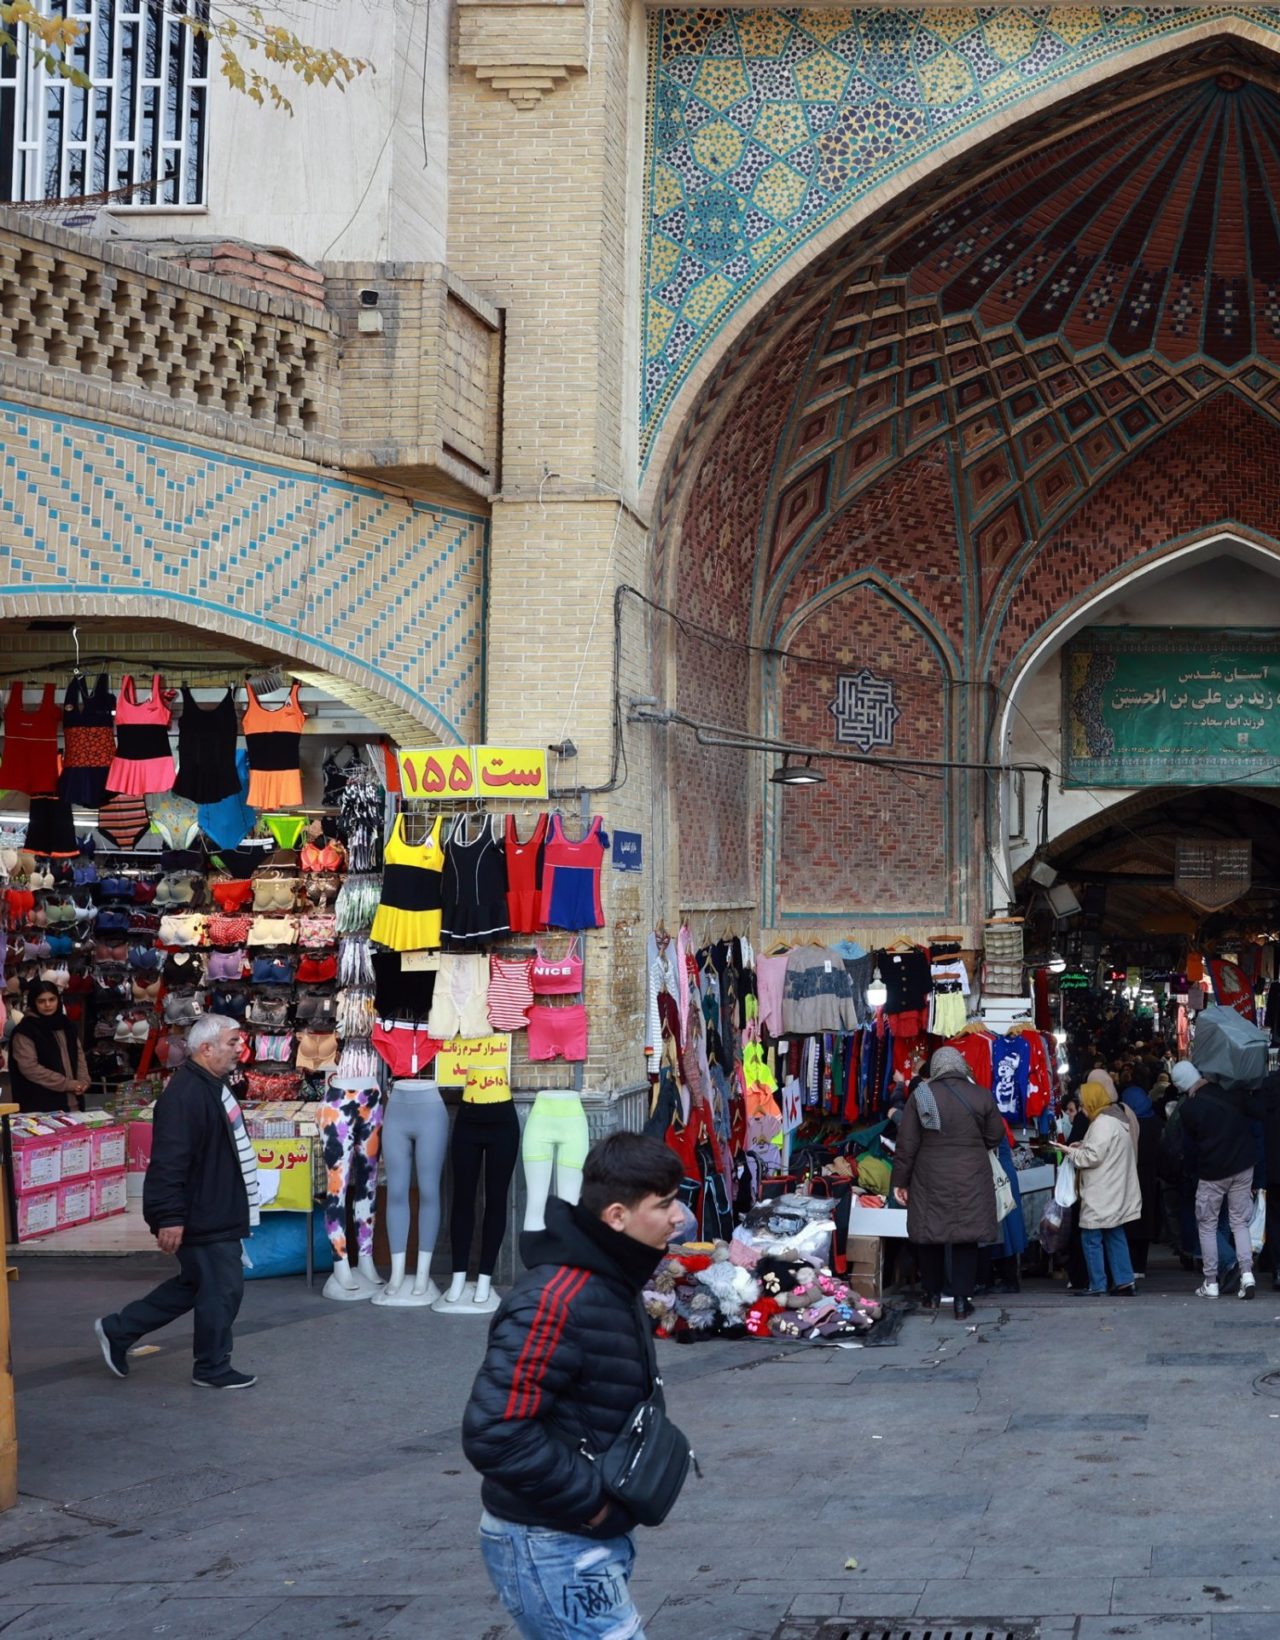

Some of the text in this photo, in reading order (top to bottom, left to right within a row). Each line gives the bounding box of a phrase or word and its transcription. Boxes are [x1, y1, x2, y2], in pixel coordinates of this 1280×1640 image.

[1178, 665, 1269, 683] آستان مقدس
[1111, 687, 1167, 710] الحسین
[1169, 691, 1188, 710] بن
[1191, 688, 1221, 710] علی
[1225, 691, 1245, 710] بن
[1249, 690, 1273, 710] زید
[1224, 717, 1241, 728] امام
[403, 754, 542, 792] ست ۱۵۵
[534, 966, 571, 976] NICE
[440, 1042, 462, 1056] زنان
[483, 1042, 508, 1056] شلوار
[480, 1076, 503, 1090] داخل
[257, 1144, 308, 1169] شورت
